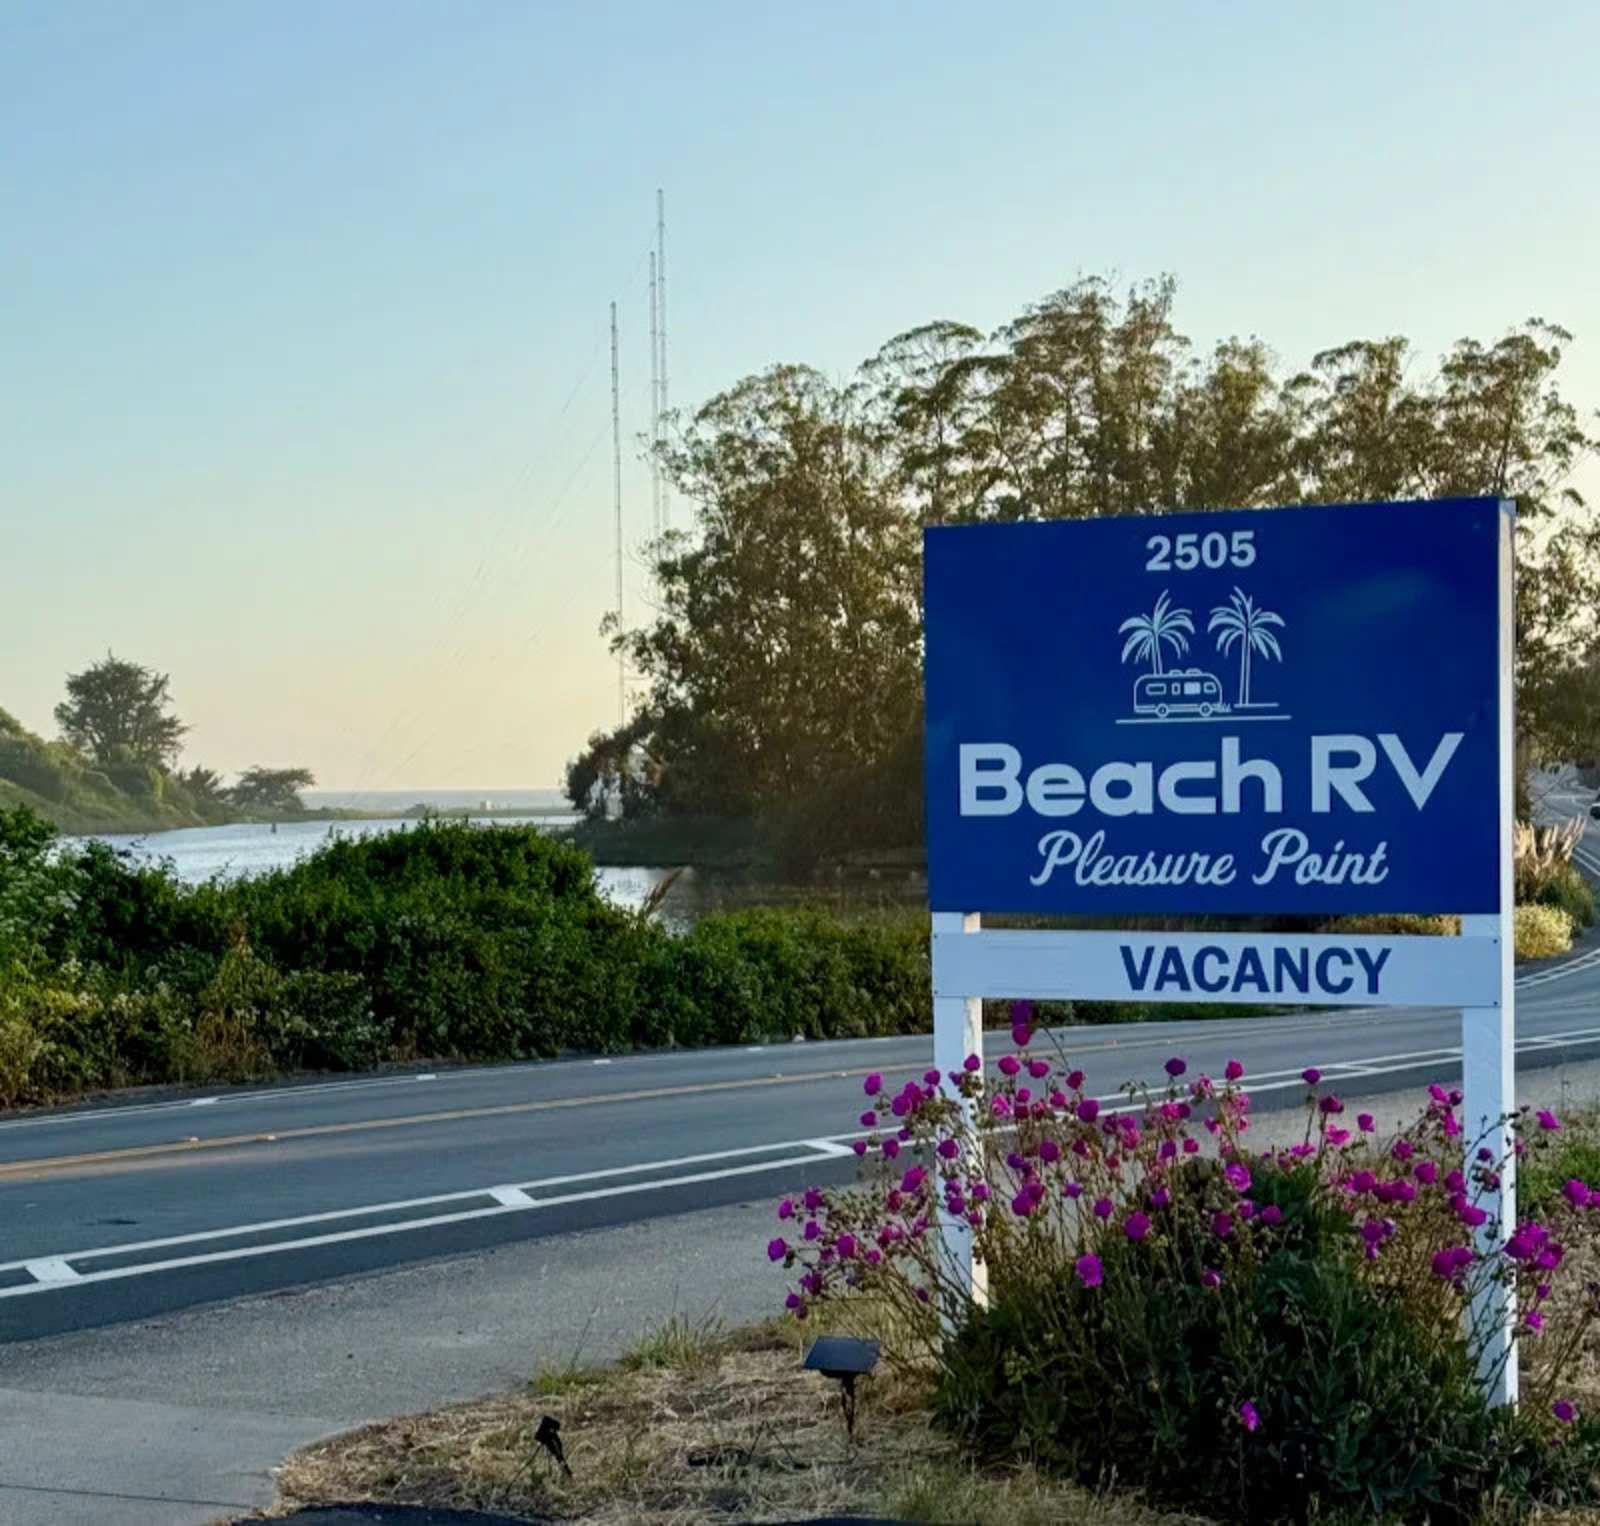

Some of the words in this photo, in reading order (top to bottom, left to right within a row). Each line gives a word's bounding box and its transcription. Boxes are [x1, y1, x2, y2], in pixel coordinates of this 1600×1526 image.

[1146, 530, 1256, 571] 2505
[959, 737, 1282, 816] Beach
[1311, 732, 1464, 812] RV
[1029, 829, 1237, 887] Pleasure
[1252, 827, 1390, 886] Point
[1119, 944, 1393, 996] VACANCY
